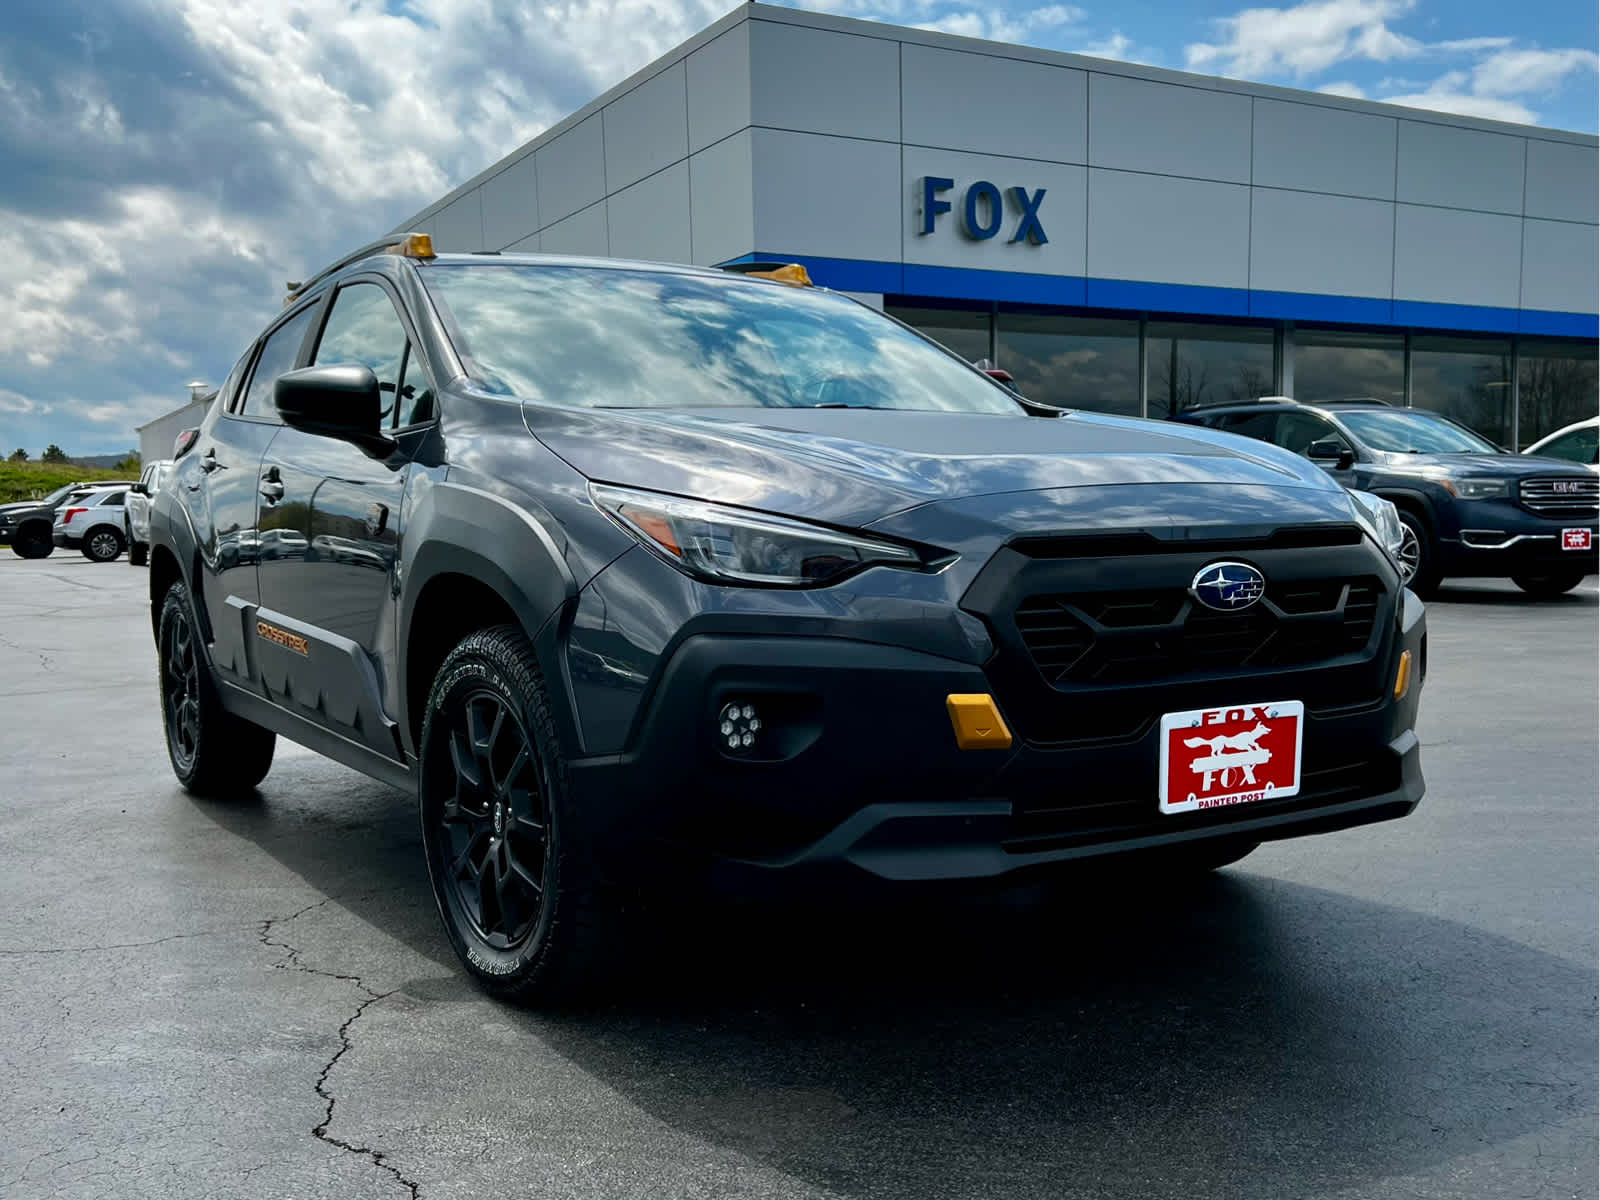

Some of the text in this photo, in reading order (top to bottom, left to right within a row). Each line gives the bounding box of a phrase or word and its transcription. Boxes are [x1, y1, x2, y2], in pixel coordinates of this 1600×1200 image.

[919, 176, 1049, 245] FOX
[257, 621, 309, 655] CROSSTREK
[1201, 705, 1271, 726] FOX
[1202, 764, 1257, 792] FOX
[1198, 792, 1266, 809] PAINTED POST
